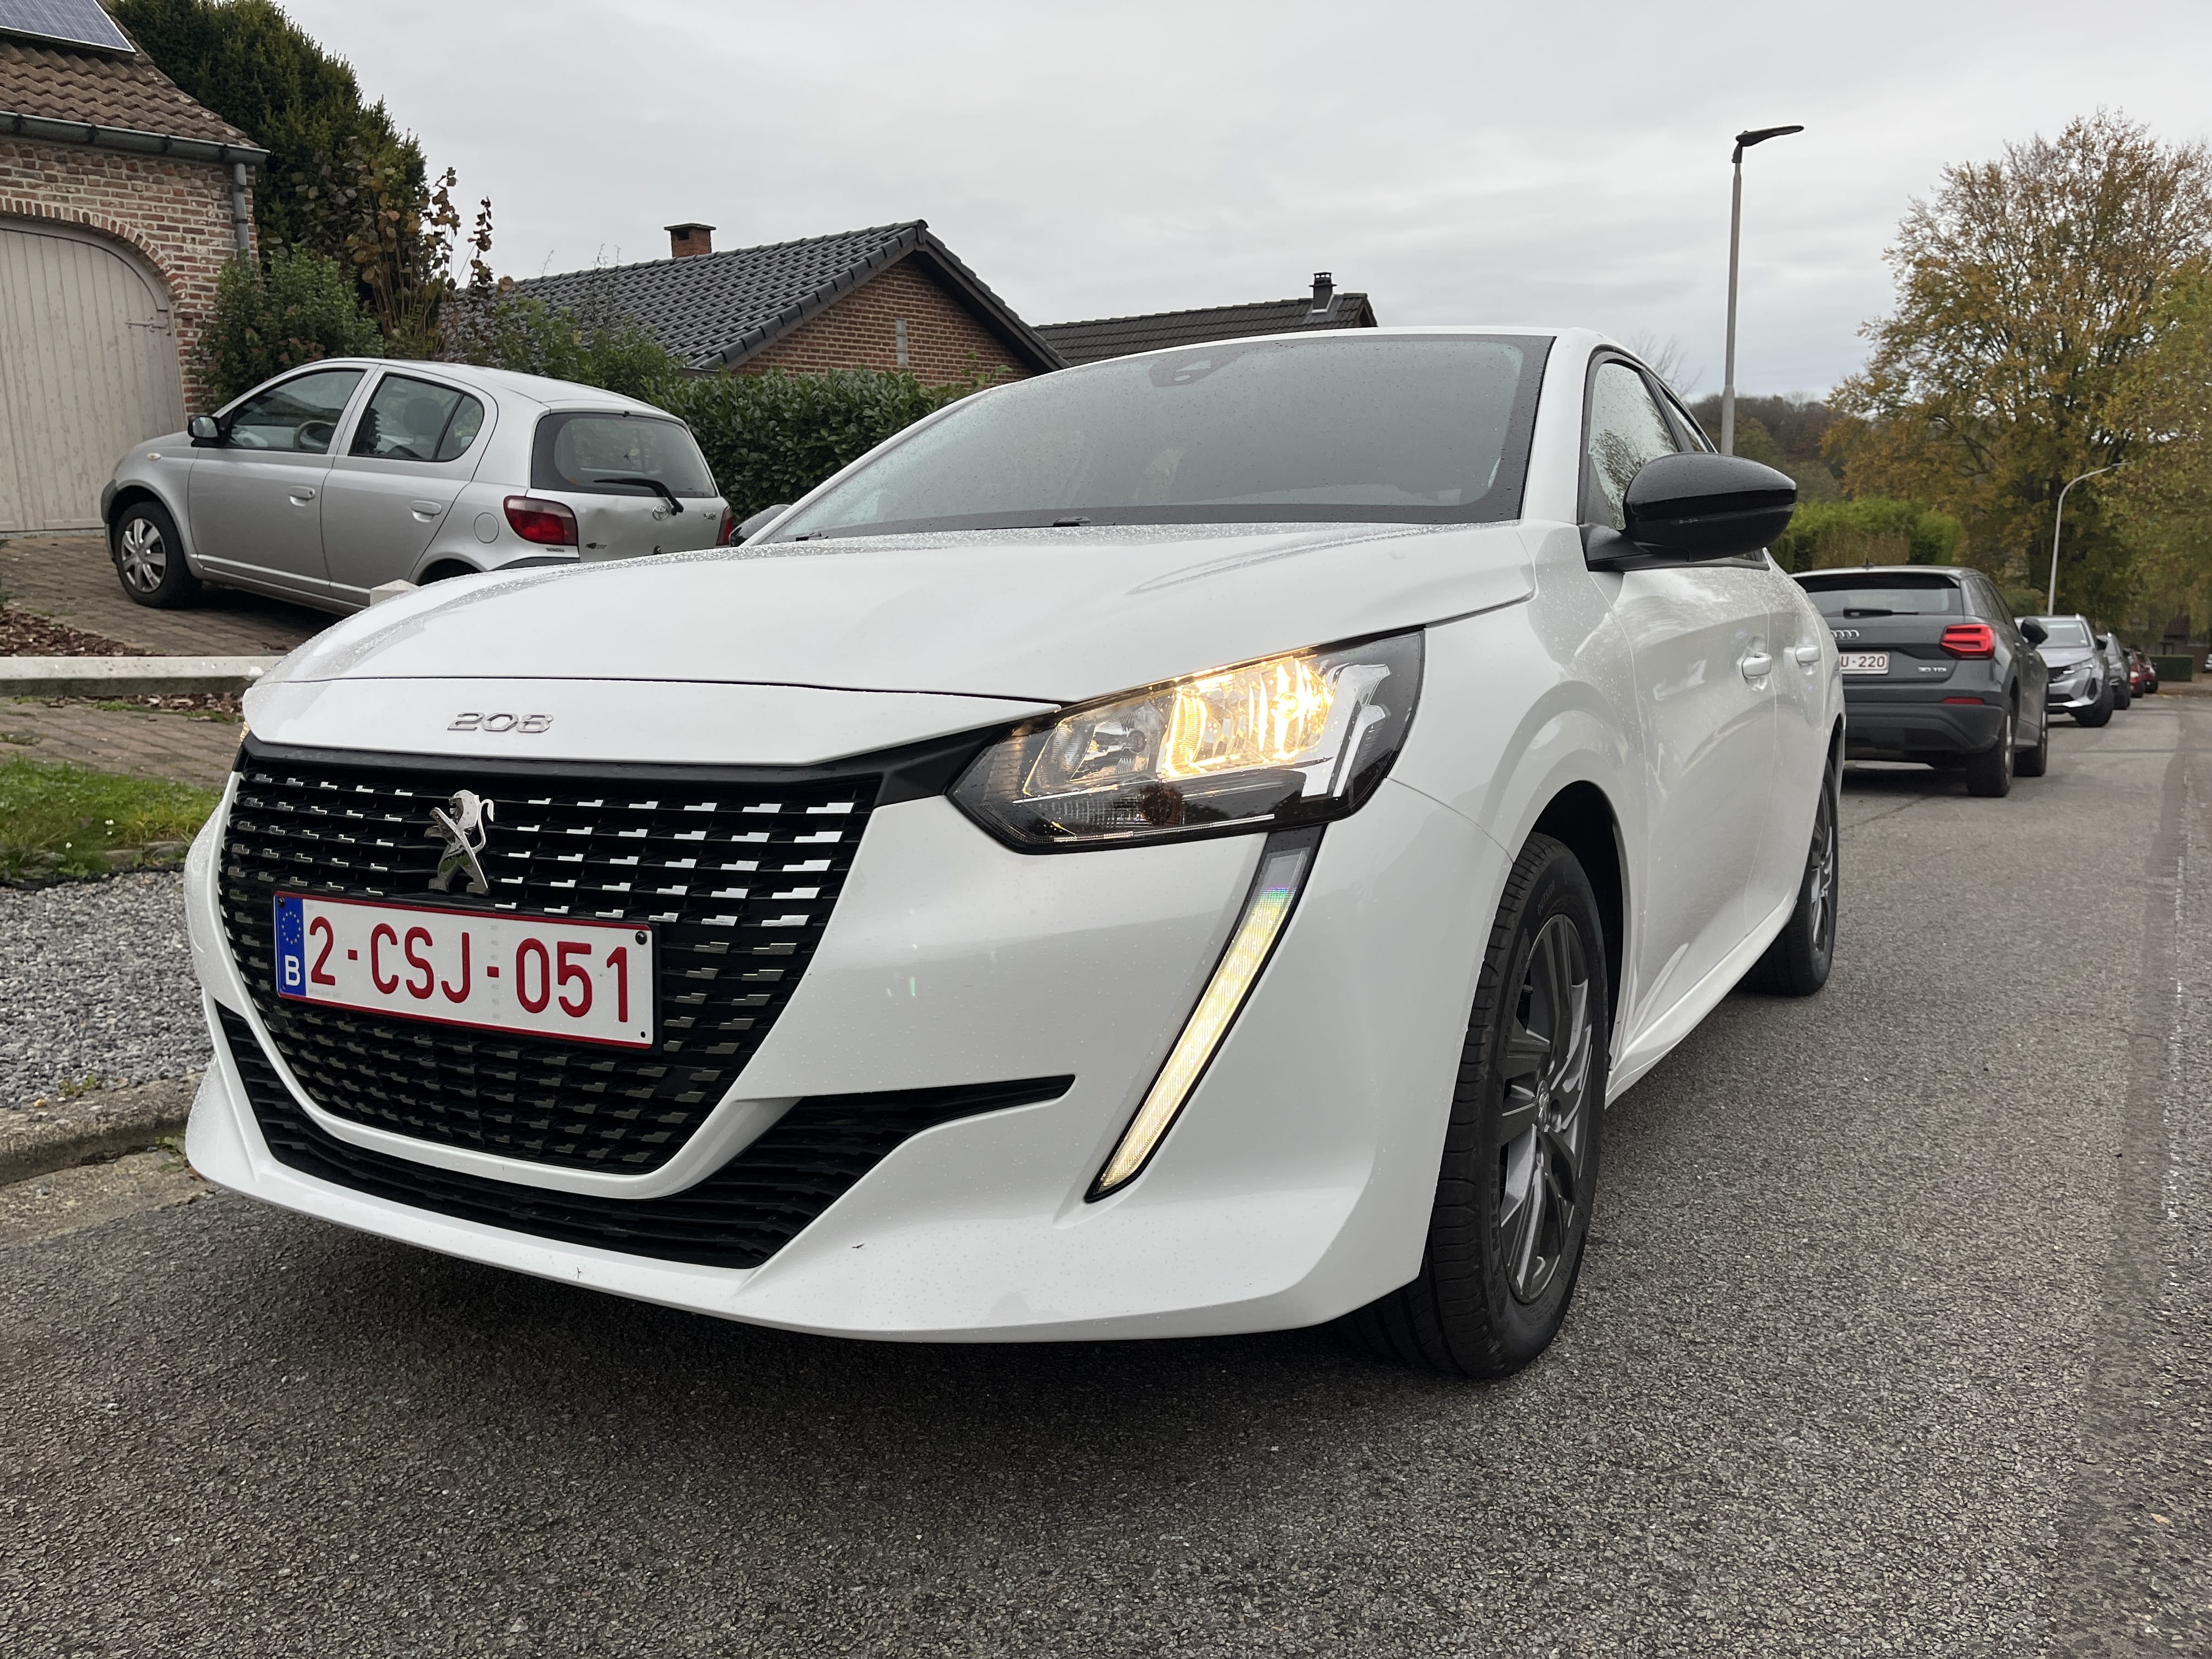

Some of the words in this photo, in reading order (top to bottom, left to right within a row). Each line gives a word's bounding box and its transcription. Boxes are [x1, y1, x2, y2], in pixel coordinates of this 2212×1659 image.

[447, 712, 554, 733] 208
[285, 955, 300, 986] B
[309, 916, 629, 1023] 2-CSJ-051
